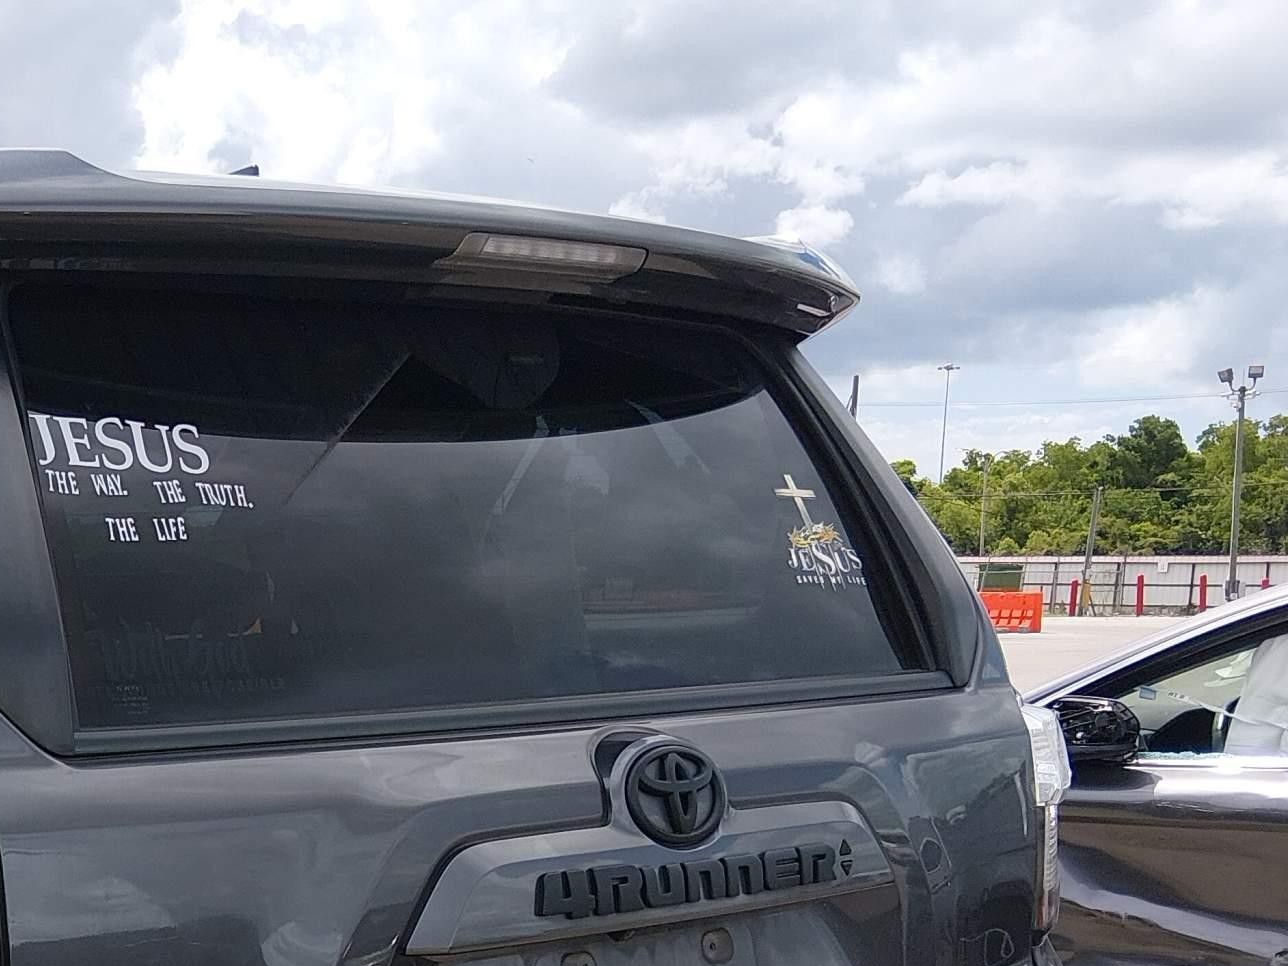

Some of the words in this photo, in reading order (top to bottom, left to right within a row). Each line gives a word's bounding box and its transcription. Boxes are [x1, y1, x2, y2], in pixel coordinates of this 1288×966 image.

[29, 414, 210, 474] JESUS
[45, 469, 80, 495] THE
[91, 474, 128, 496] WAY.
[153, 479, 187, 504] THE
[195, 482, 254, 508] TRUTH.
[105, 517, 139, 541] THE
[153, 516, 188, 541] LIFE
[788, 542, 862, 575] JESUS
